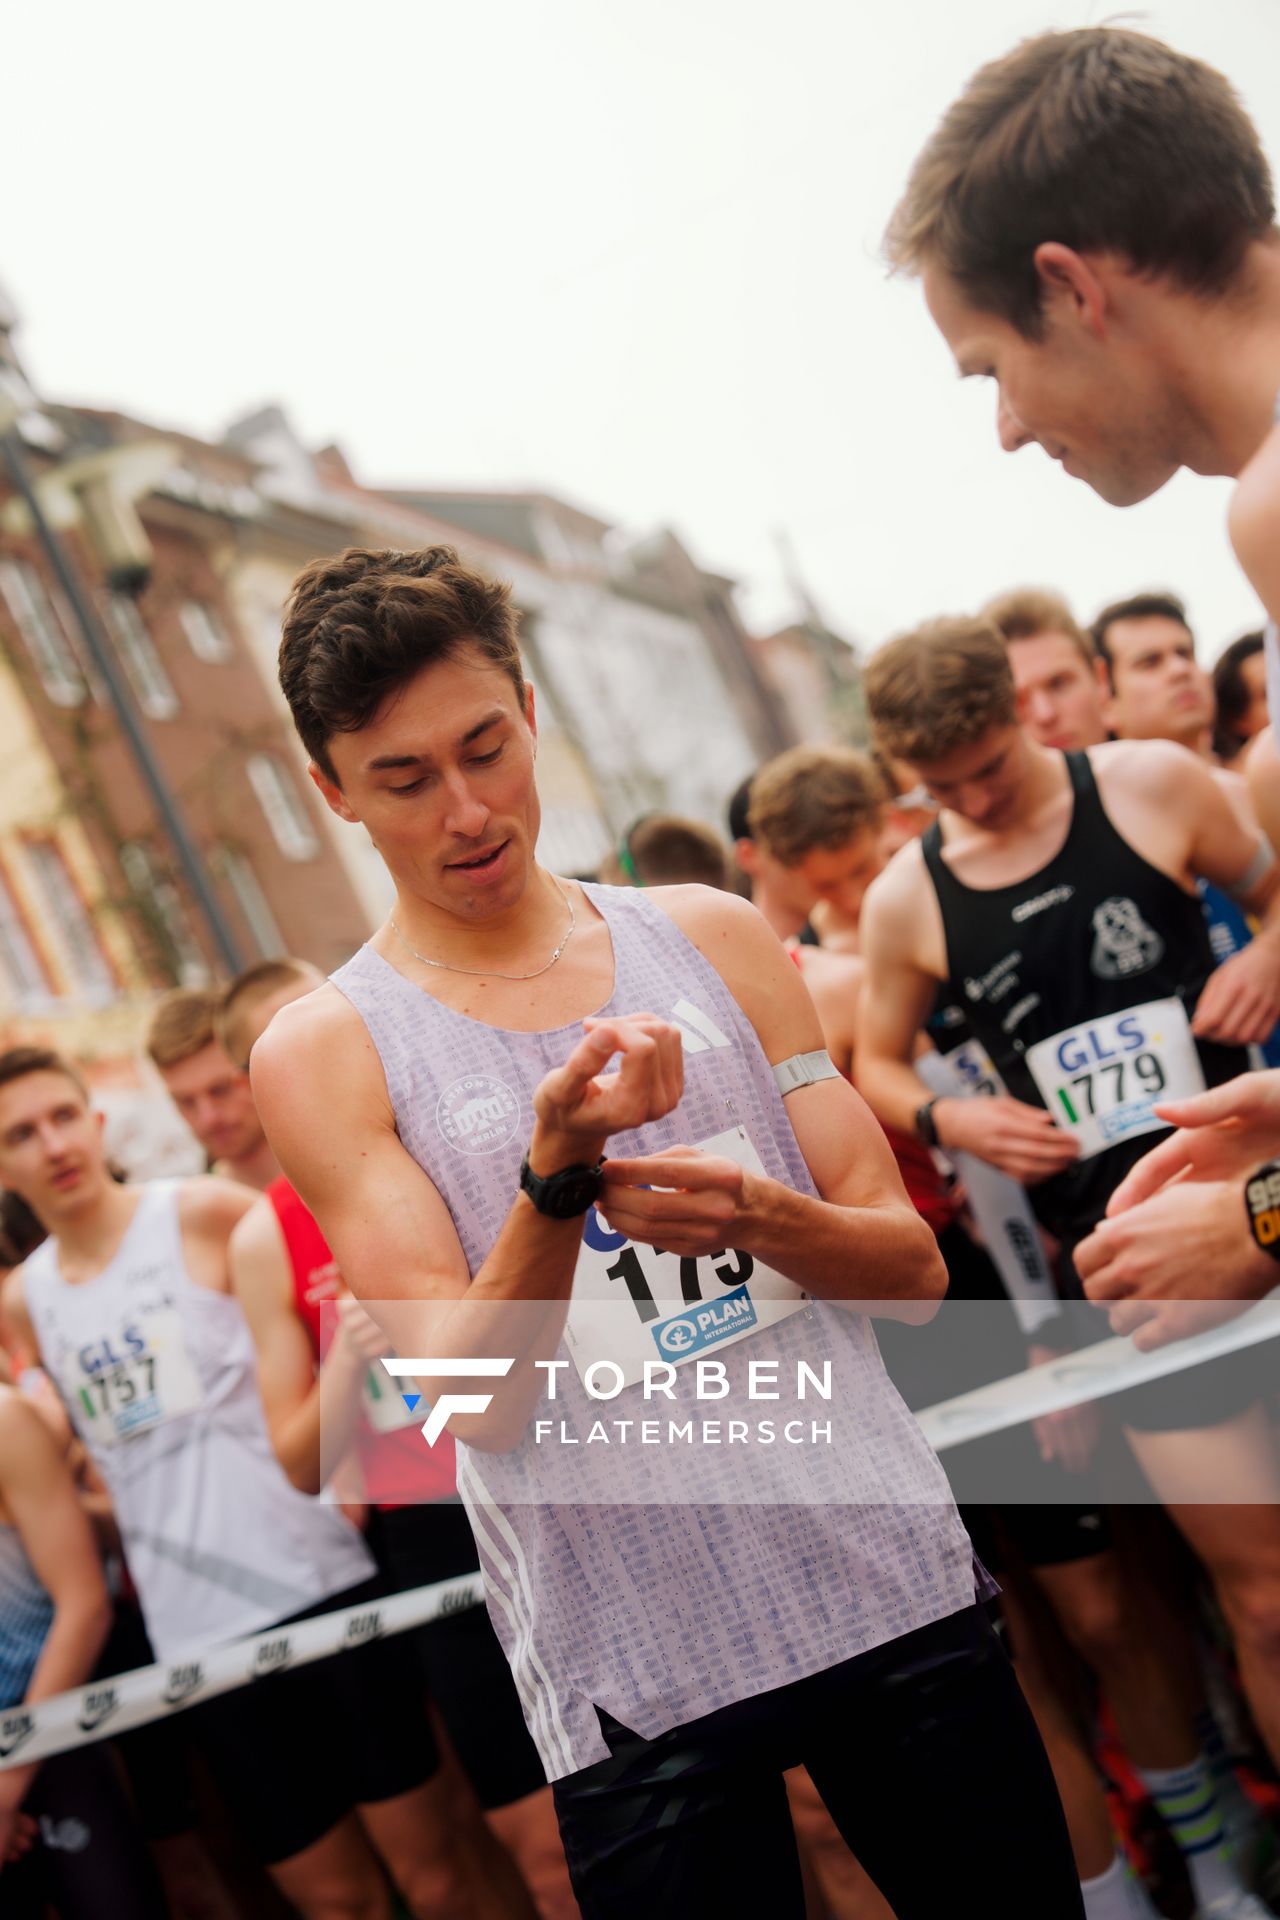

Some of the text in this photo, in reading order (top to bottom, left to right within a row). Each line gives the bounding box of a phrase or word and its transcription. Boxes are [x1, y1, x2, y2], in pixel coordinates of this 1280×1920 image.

[1057, 1016, 1145, 1073] GLS
[469, 1124, 508, 1147] BERLIN
[697, 1295, 750, 1332] PLAN
[704, 1316, 753, 1341] INTERNATIONAL
[79, 1325, 146, 1375] GLS
